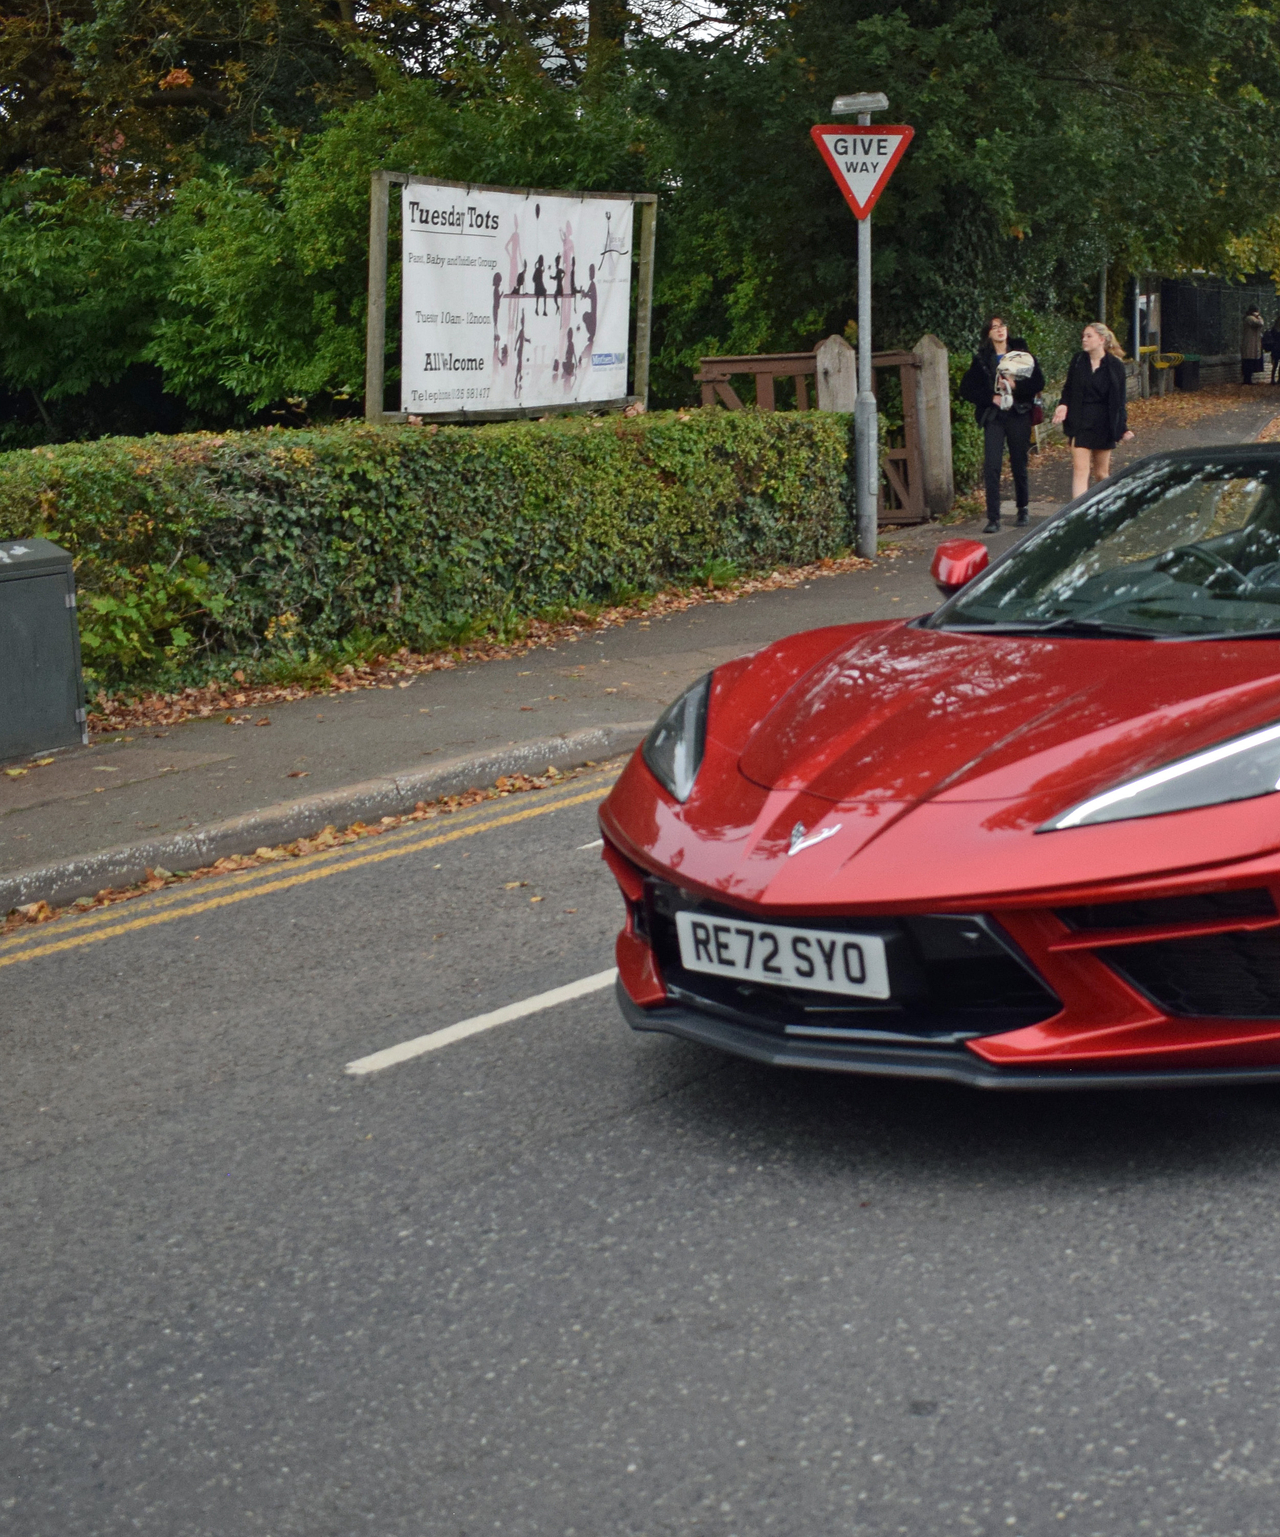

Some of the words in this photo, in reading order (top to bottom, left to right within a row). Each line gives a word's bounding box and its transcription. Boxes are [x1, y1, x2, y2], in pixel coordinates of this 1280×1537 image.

[833, 138, 888, 156] GIVE
[845, 161, 879, 173] WAY
[409, 201, 465, 234] Tuesday
[467, 206, 499, 230] Tots
[426, 253, 446, 268] Baby
[478, 257, 498, 270] Group
[424, 353, 440, 371] All
[691, 920, 782, 974] RE72
[791, 935, 866, 984] SYO
